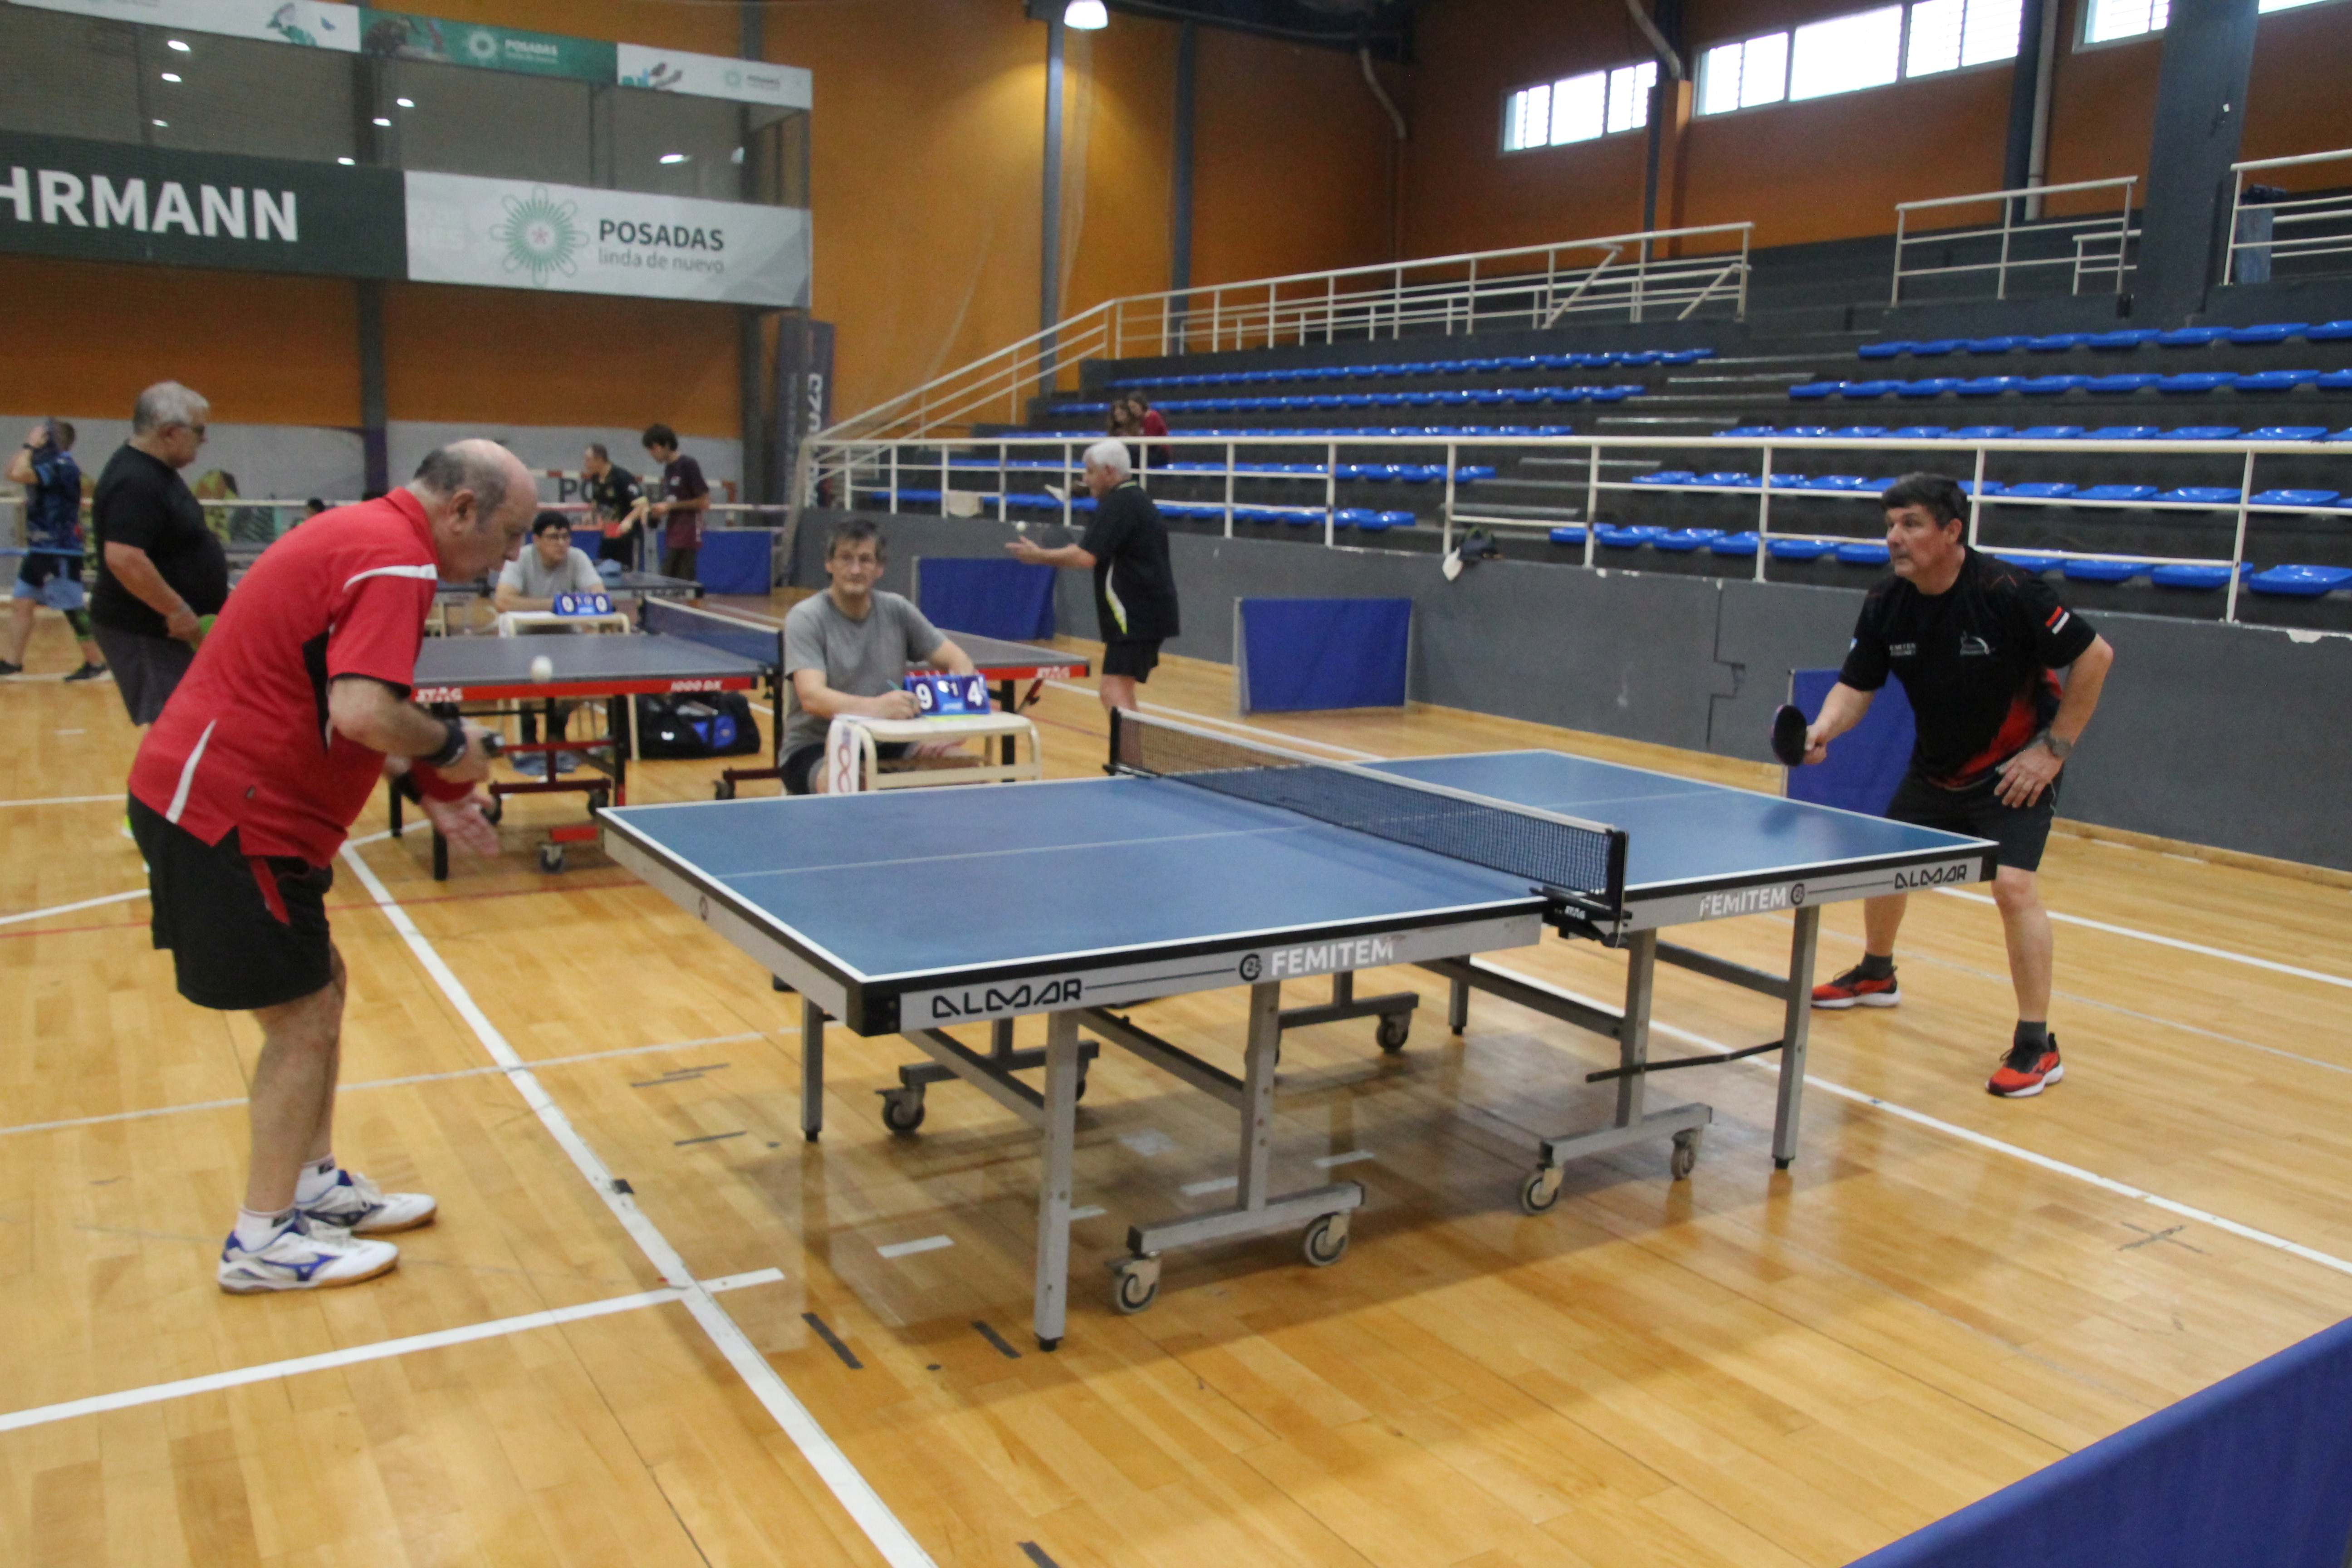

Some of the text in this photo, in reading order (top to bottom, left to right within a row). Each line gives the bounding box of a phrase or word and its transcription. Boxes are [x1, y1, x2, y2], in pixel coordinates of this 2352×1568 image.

[599, 219, 724, 251] POSADAS
[598, 247, 724, 274] linda de nuevo
[415, 686, 462, 703] STAG
[916, 683, 933, 710] 9
[967, 680, 983, 706] 4
[1895, 864, 1967, 890] ALMAR
[1699, 887, 1786, 917] FEMITEM
[1271, 938, 1394, 977] FEMITEM
[932, 978, 1082, 1018] ALMAR
